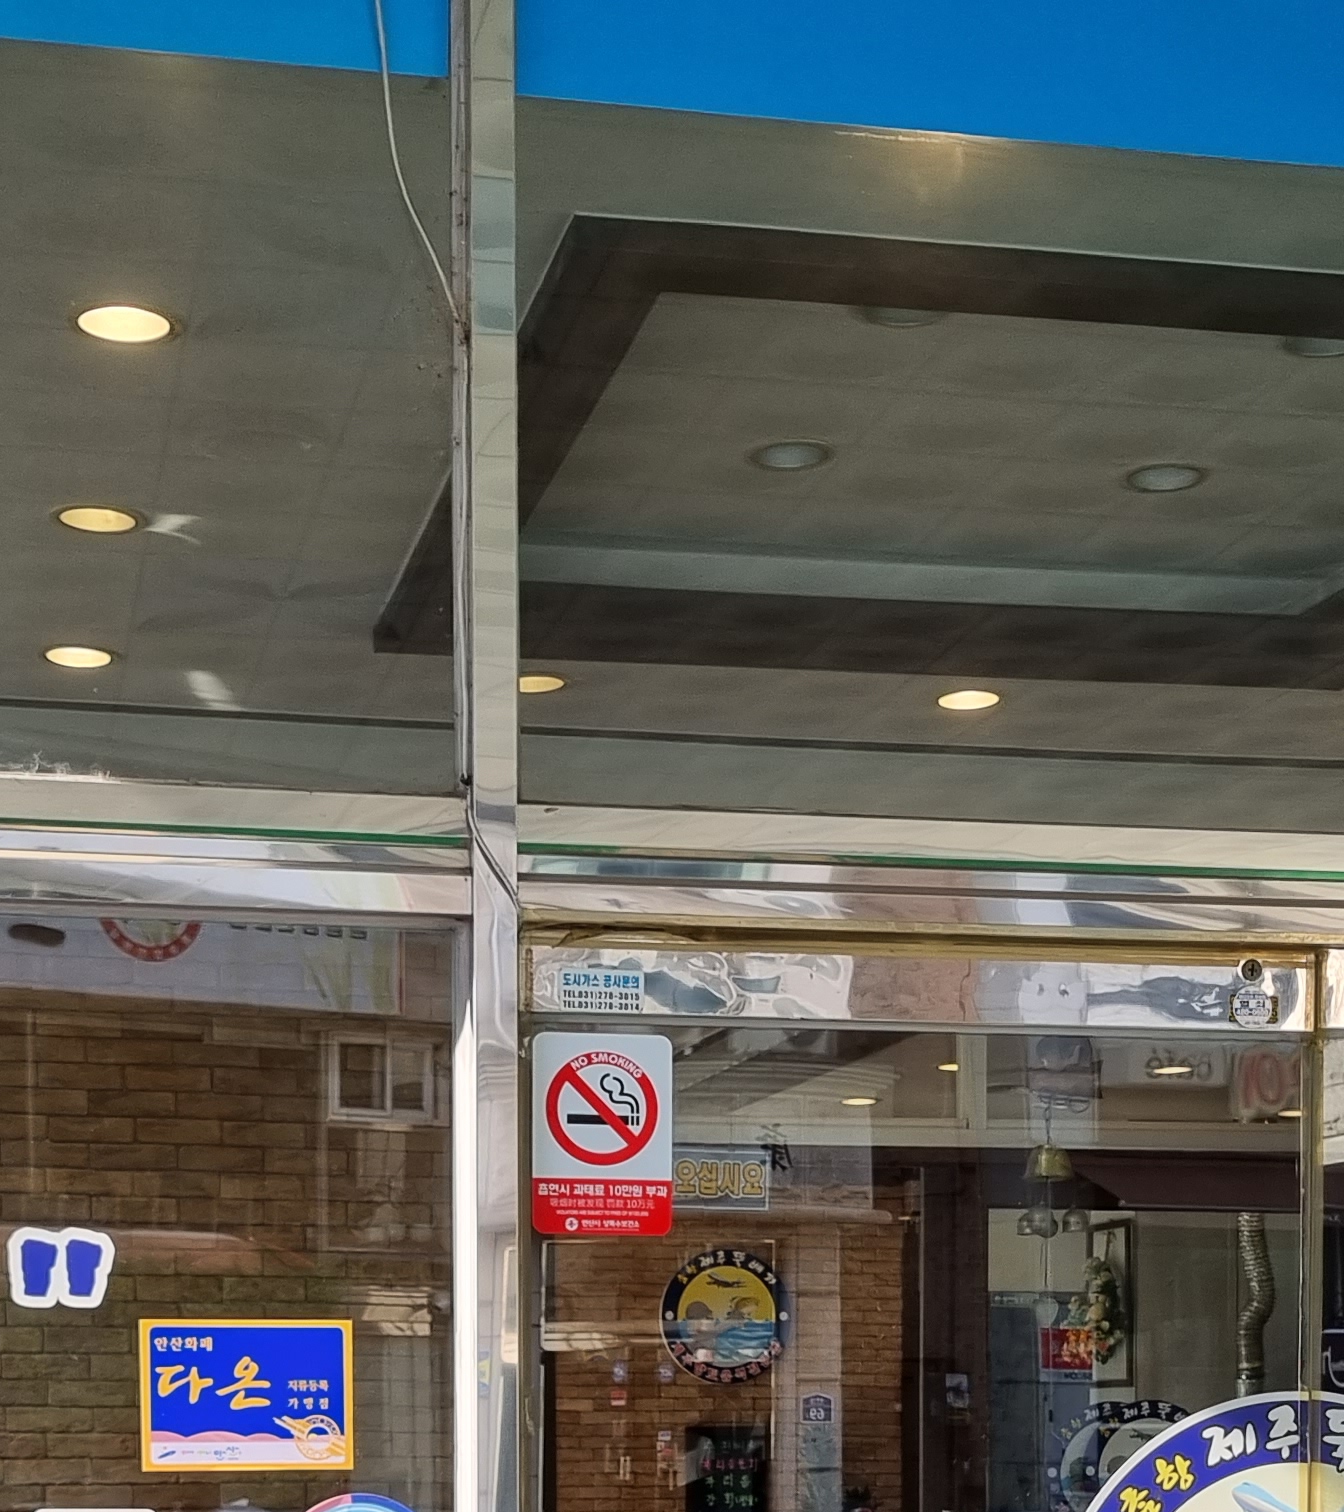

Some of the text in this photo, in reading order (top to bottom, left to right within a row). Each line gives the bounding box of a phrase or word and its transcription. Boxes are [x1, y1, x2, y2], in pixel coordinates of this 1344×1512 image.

[563, 973, 640, 988] 도시가스 공사문의
[571, 1053, 643, 1078] NO SMOKING
[538, 1183, 668, 1198] 흡연시 과태료 10만원 부과
[155, 1356, 271, 1410] 다온
